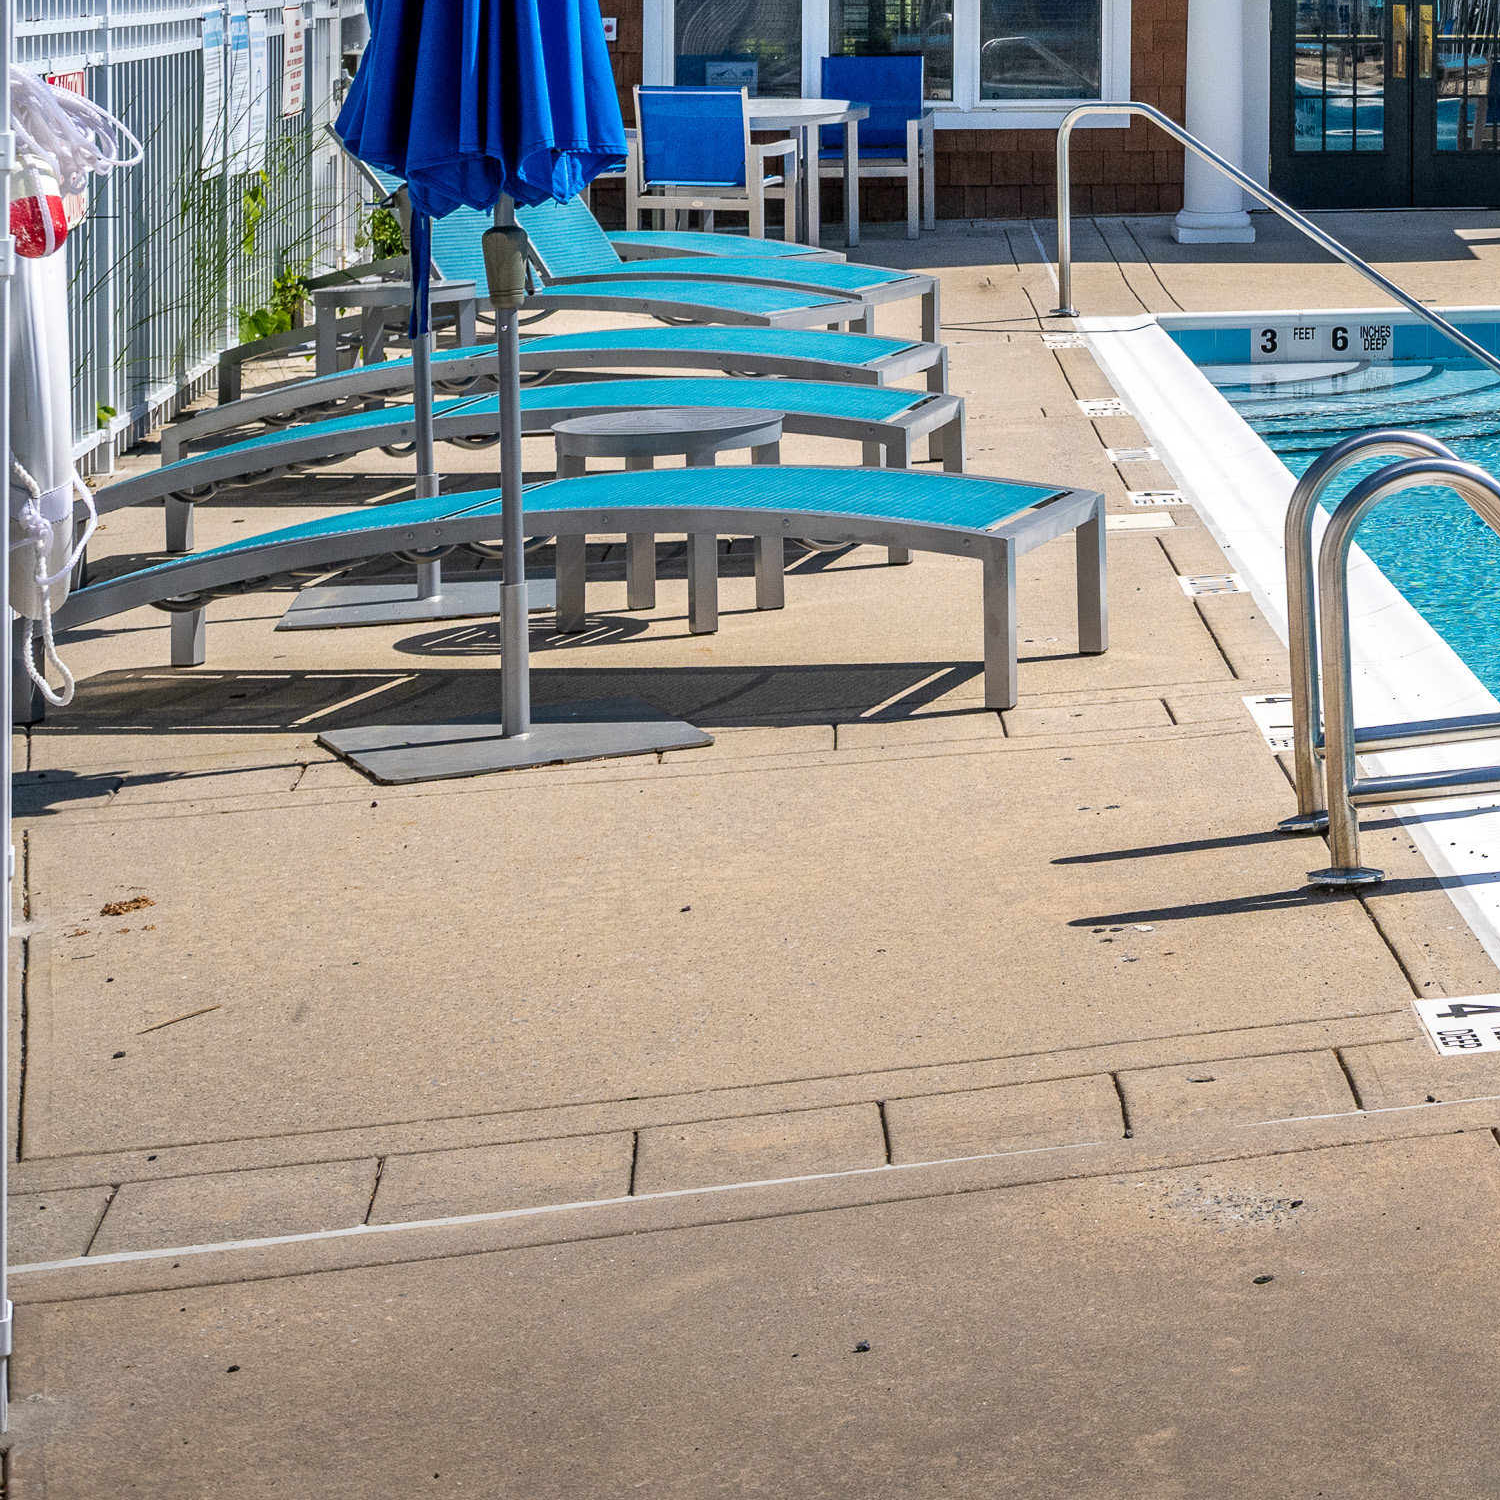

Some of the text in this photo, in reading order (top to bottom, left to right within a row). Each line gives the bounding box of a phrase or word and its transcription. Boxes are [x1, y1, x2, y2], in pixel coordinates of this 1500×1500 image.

[1261, 326, 1391, 353] 3 FEET 6 INCHES
[1364, 338, 1387, 350] DEEP
